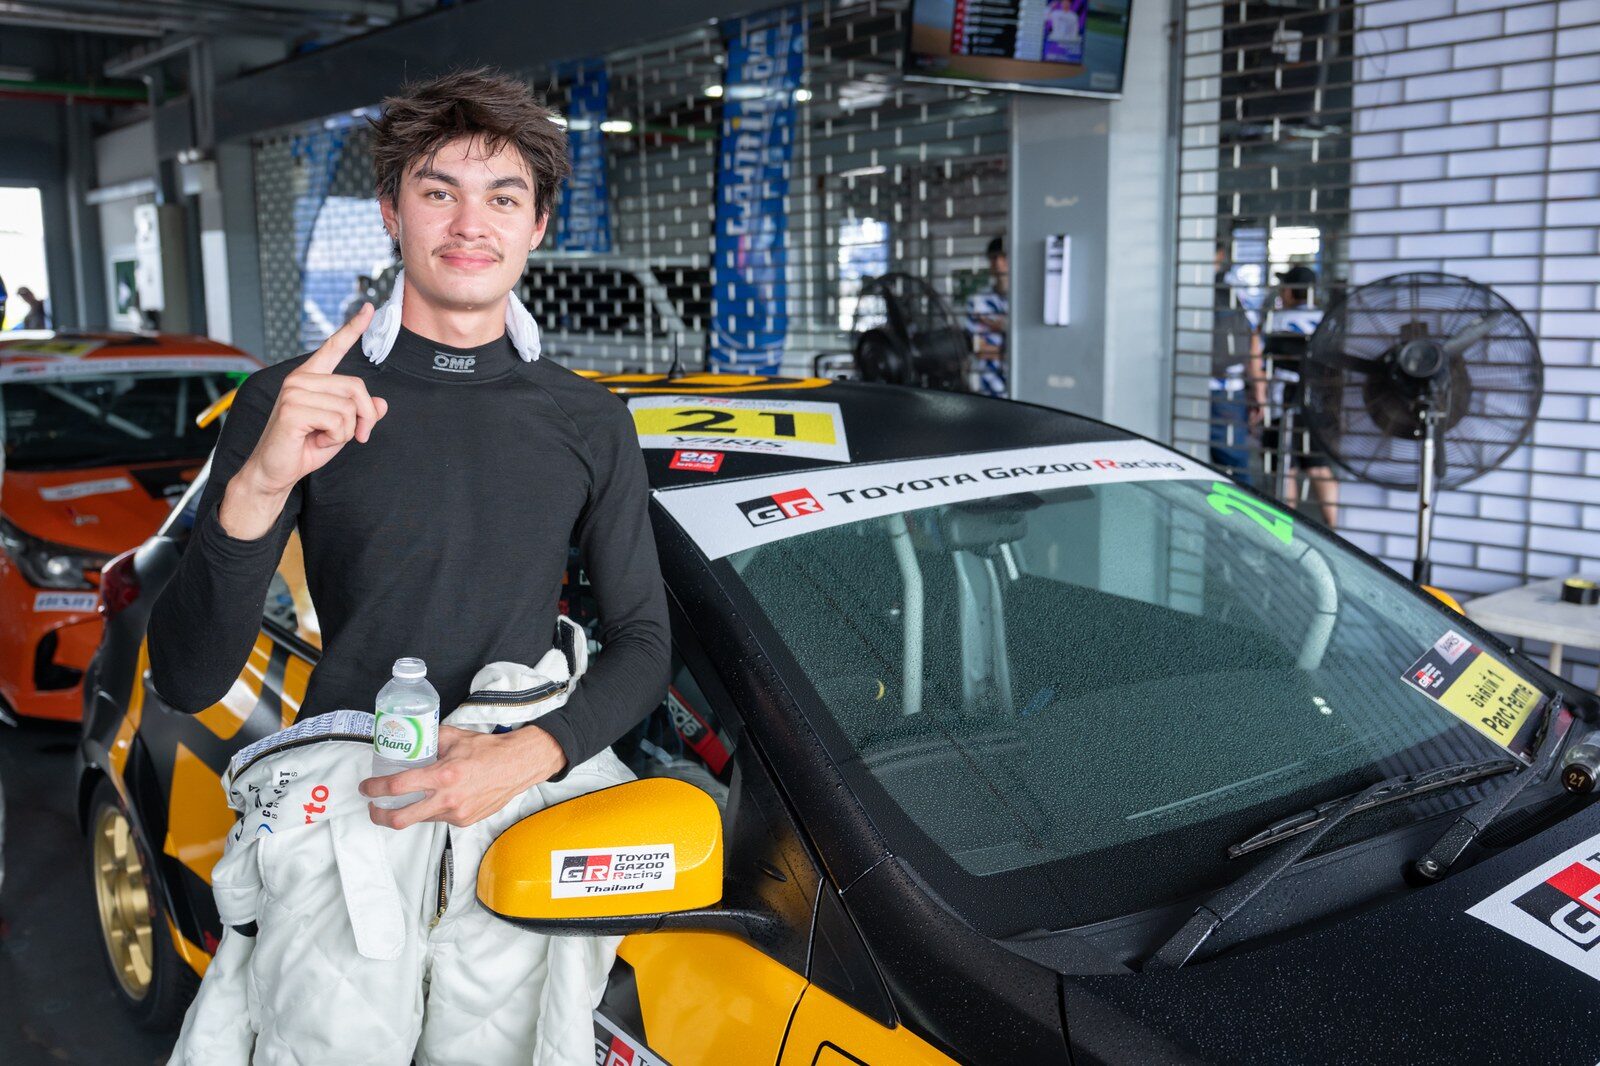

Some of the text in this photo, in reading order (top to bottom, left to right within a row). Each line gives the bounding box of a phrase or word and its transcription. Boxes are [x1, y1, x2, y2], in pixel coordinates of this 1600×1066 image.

[434, 354, 476, 370] OMP
[666, 409, 796, 437] 21
[675, 436, 783, 448] YARIS
[744, 459, 1185, 527] GR TOYOTA GAZOO Racing
[1206, 481, 1294, 544] 21
[1481, 683, 1534, 736] Parc Ferme
[377, 734, 412, 753] Chang
[1569, 772, 1585, 788] 21
[616, 852, 670, 862] TOYOTA
[560, 861, 609, 882] GR
[614, 861, 664, 871] GAZOO
[612, 870, 662, 880] Racing
[585, 882, 645, 893] Thailand
